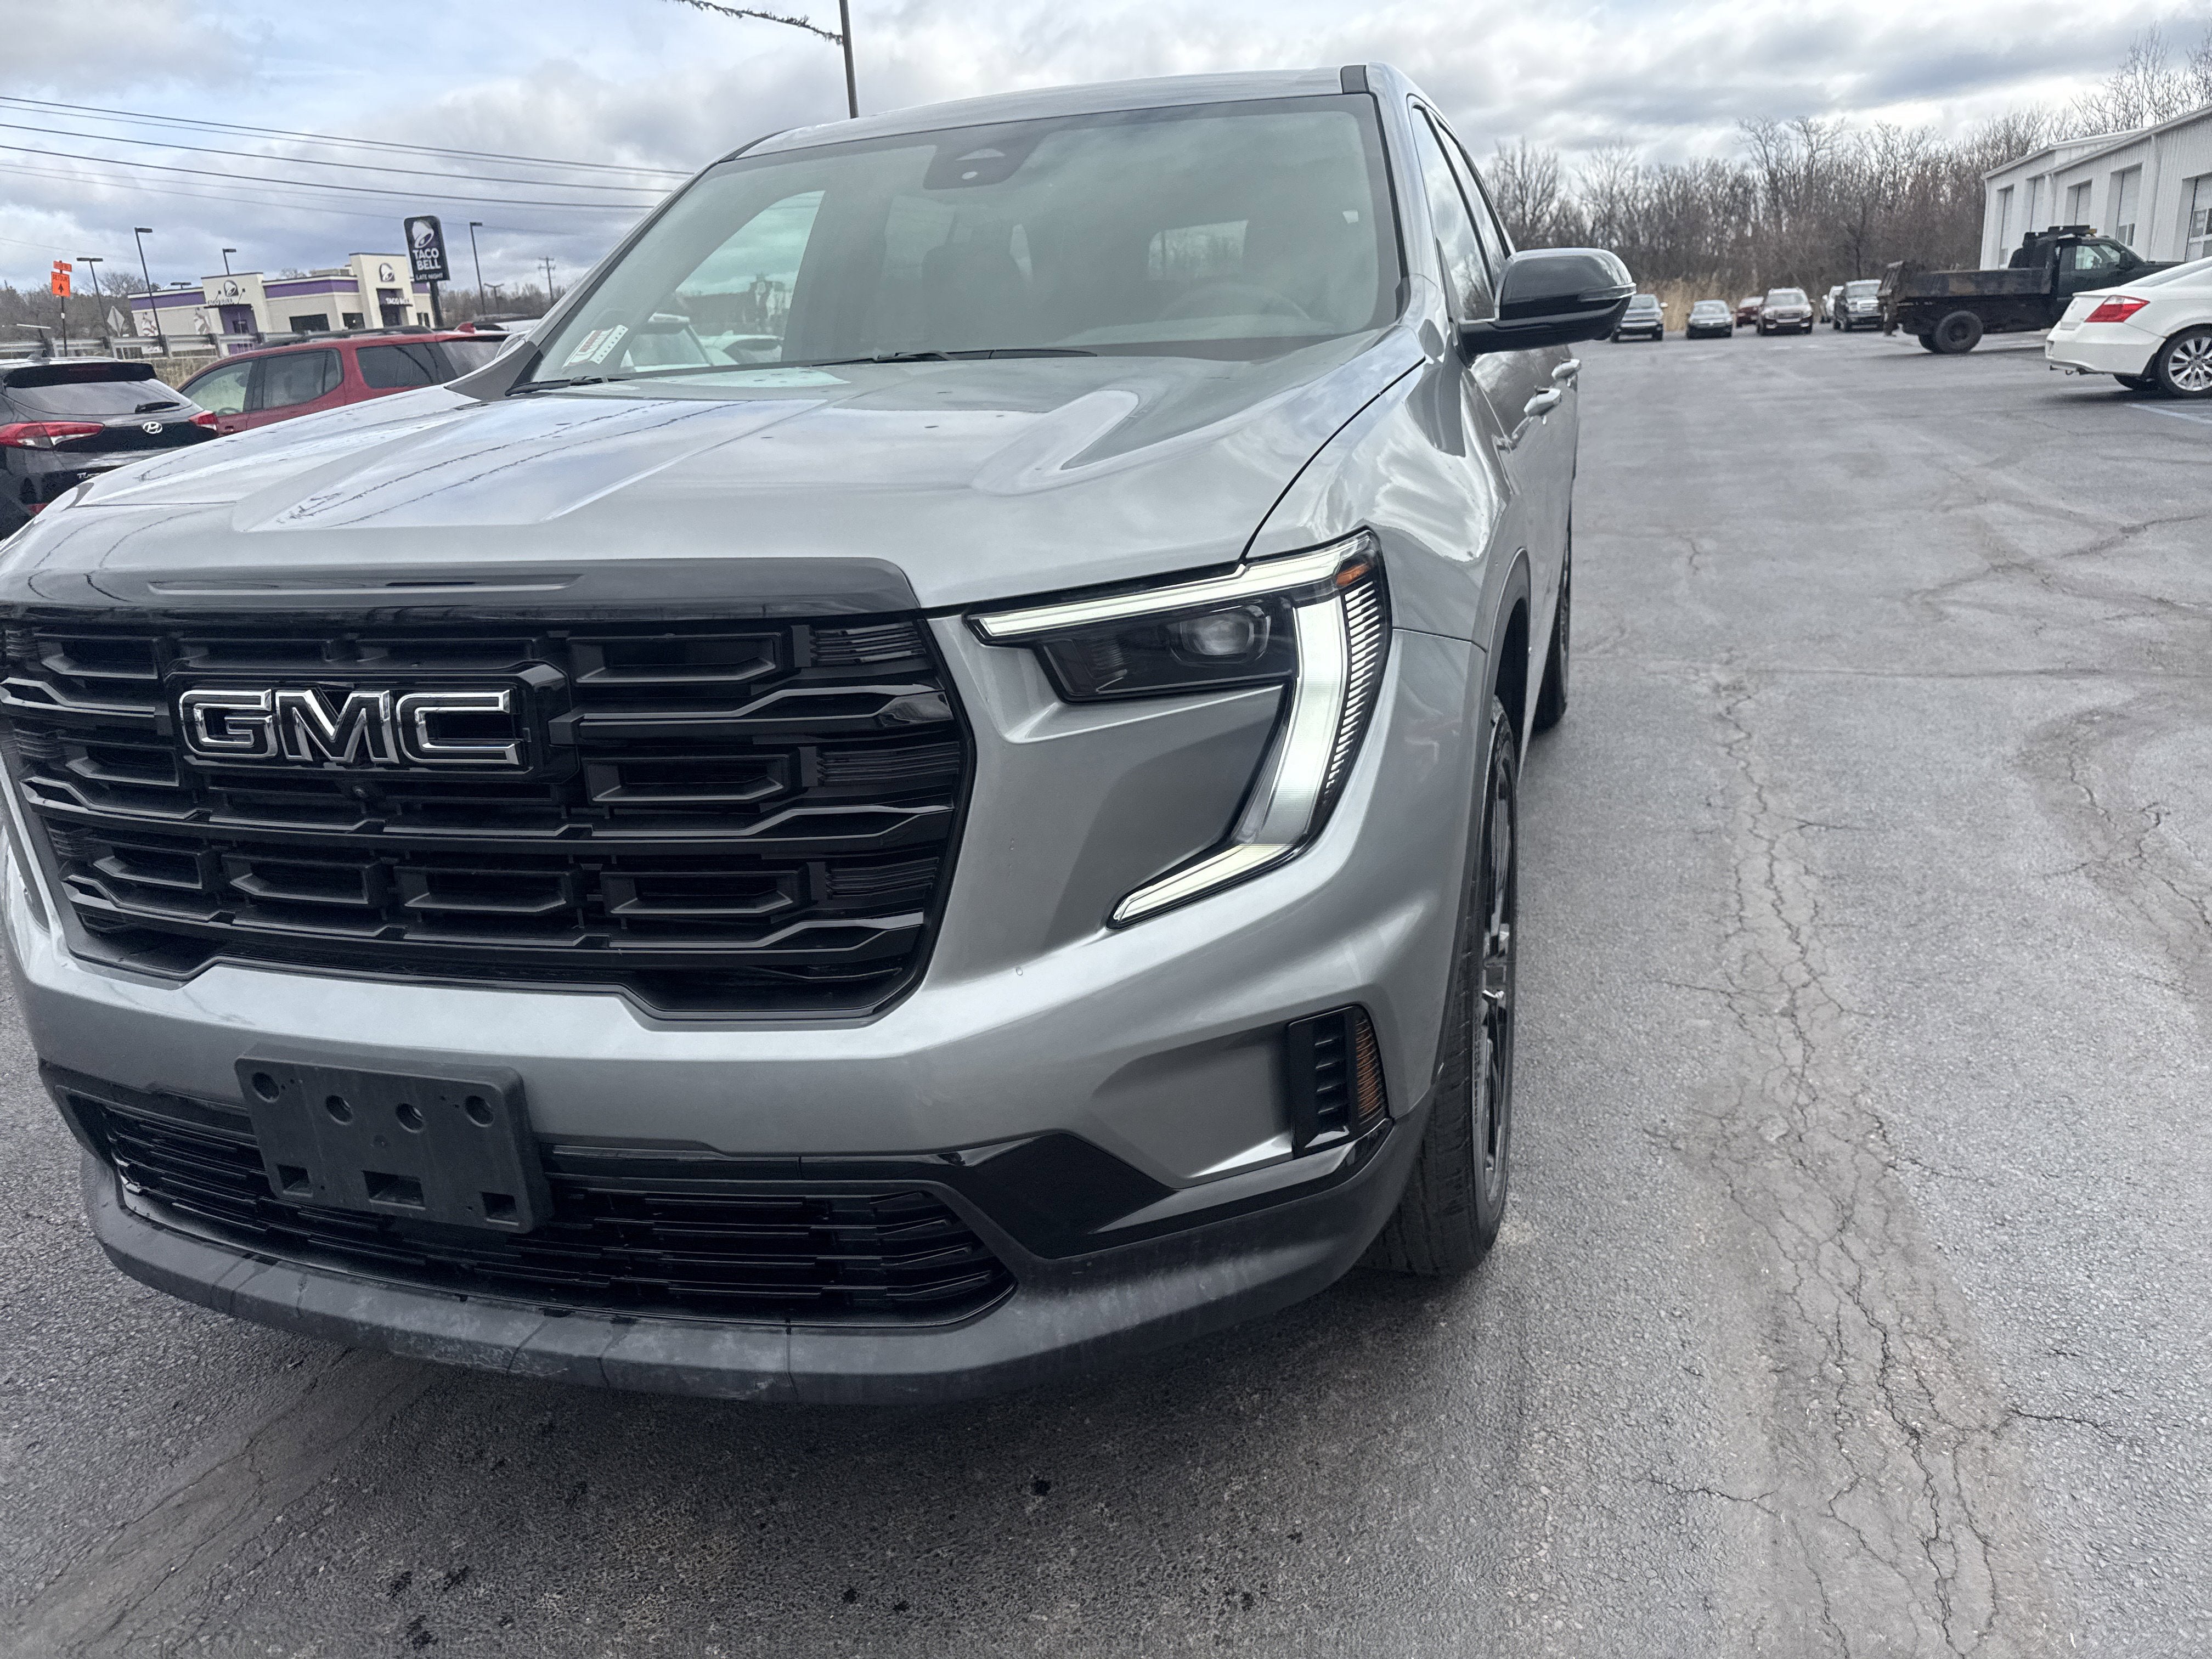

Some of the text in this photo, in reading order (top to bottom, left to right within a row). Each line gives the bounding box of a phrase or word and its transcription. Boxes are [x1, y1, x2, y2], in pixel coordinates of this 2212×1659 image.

[413, 247, 439, 259] TACO
[416, 258, 441, 270] BELL
[179, 689, 520, 765] GMC
